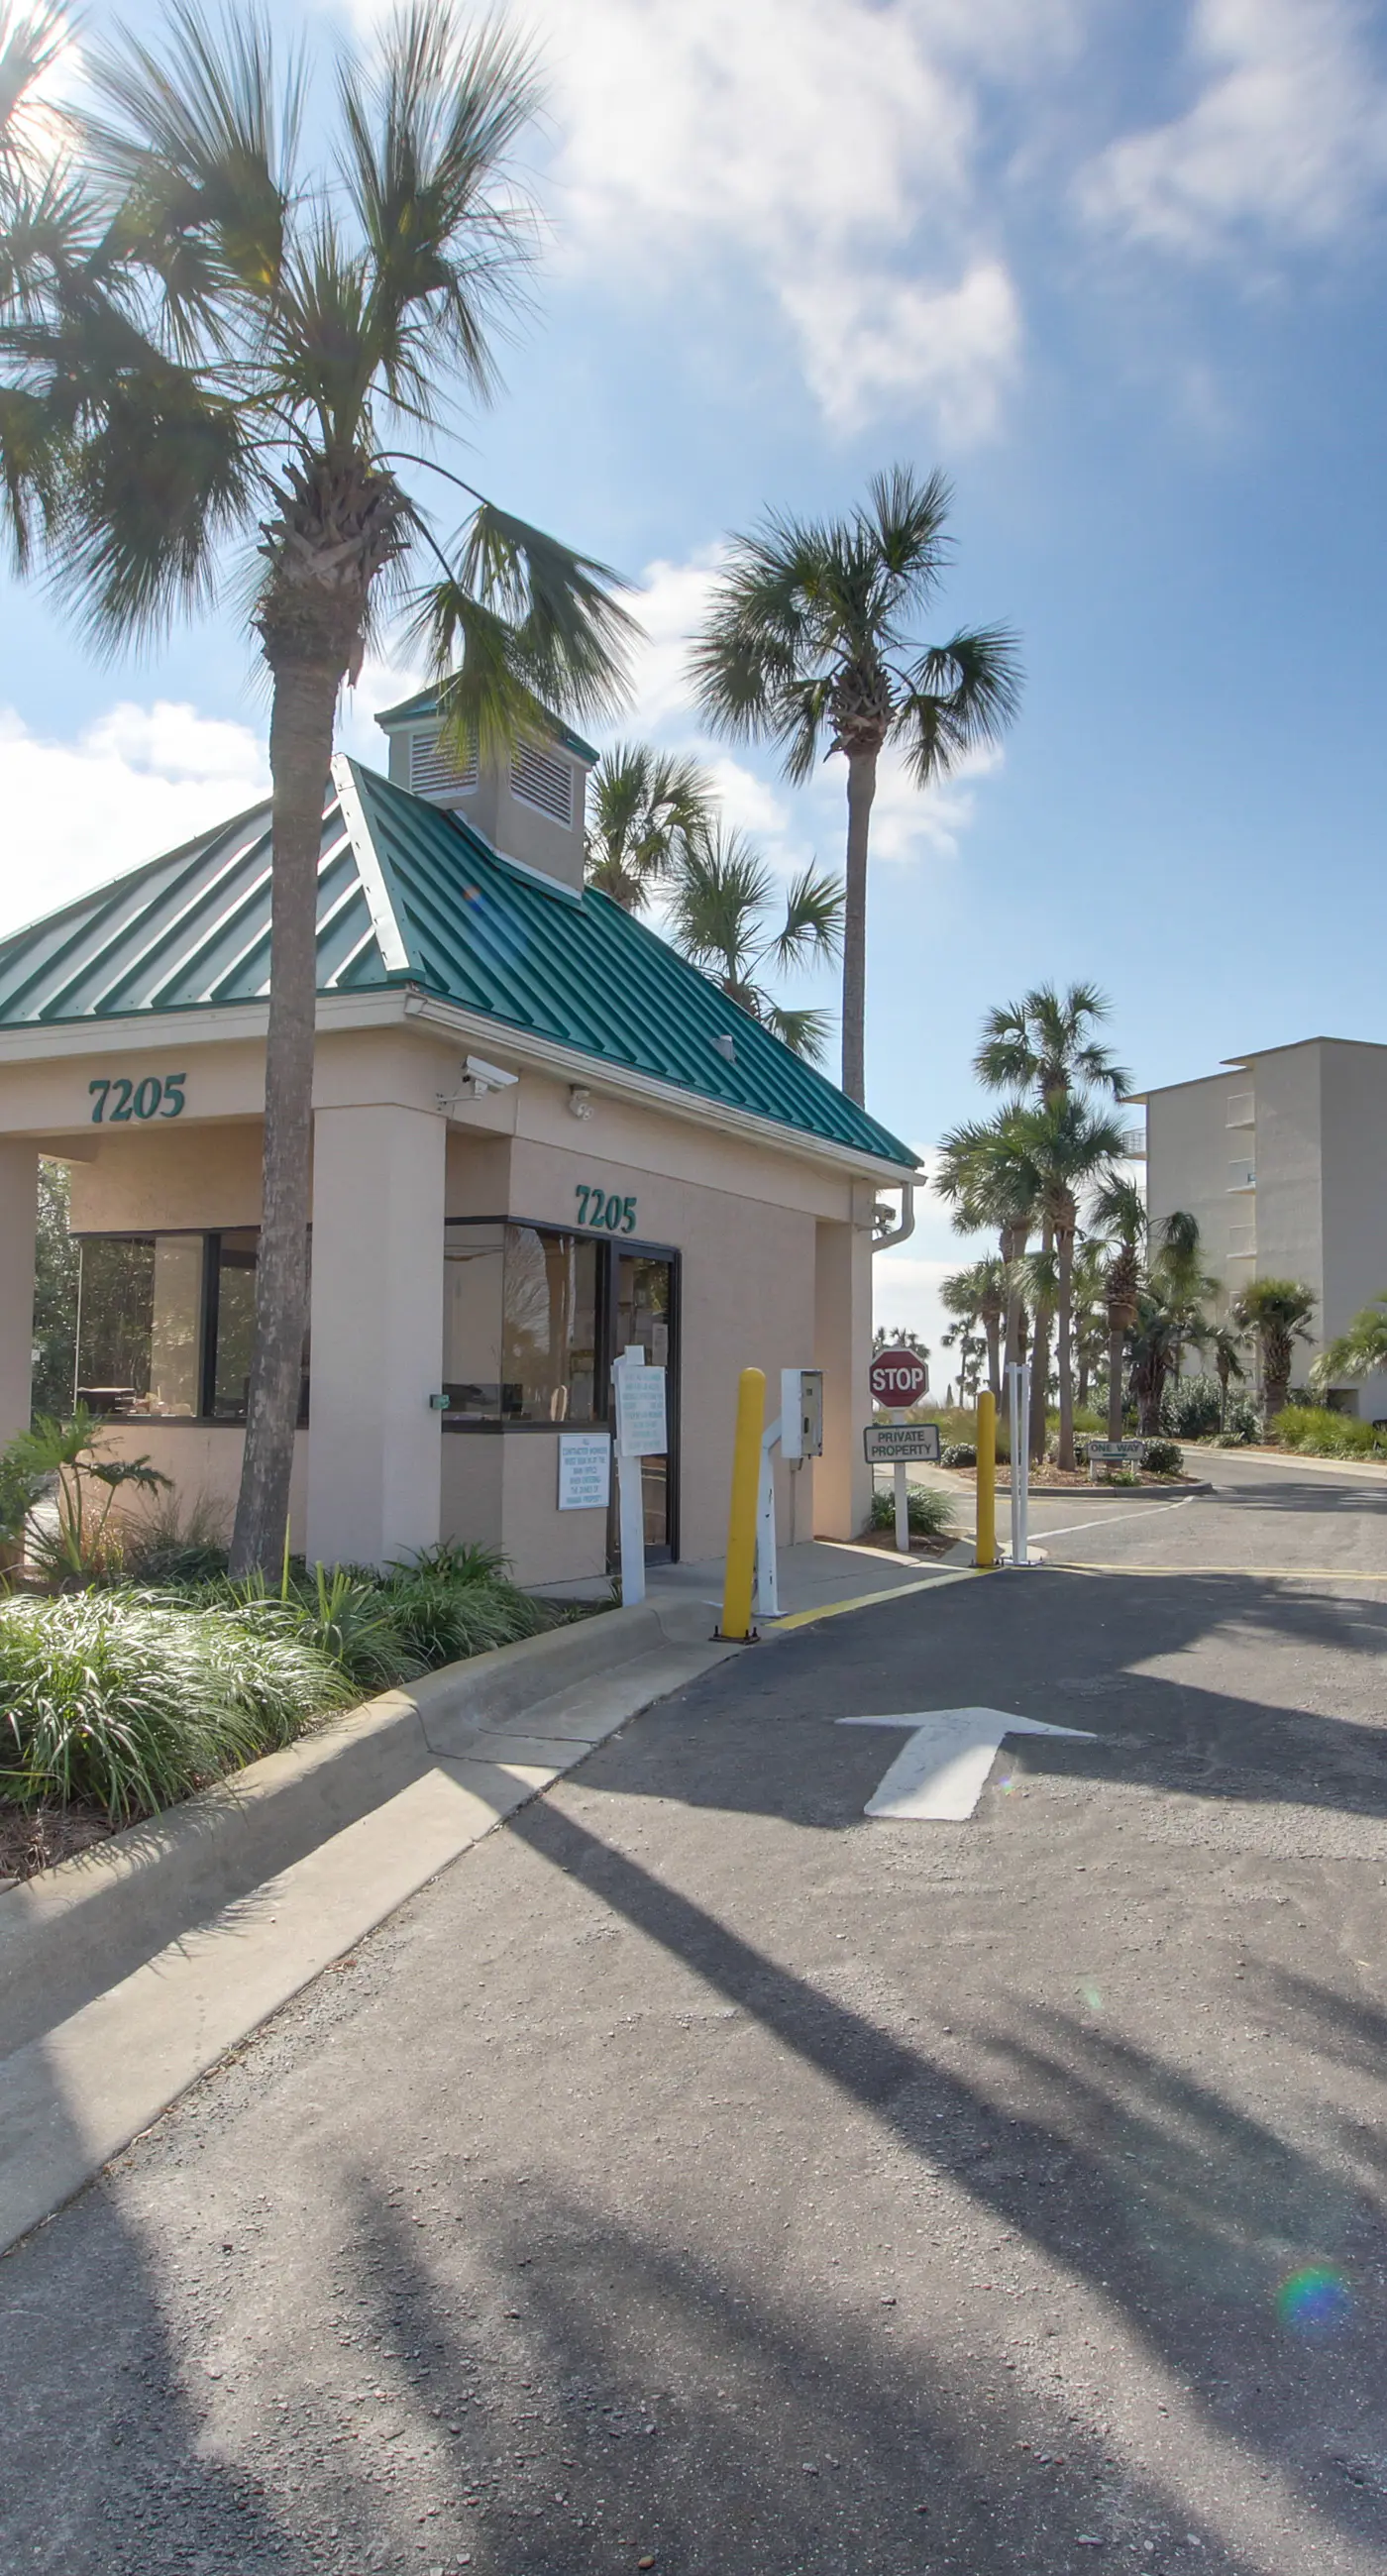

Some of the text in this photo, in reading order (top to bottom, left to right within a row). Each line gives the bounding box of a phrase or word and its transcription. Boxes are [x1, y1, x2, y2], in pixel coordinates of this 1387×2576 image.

[89, 1072, 186, 1124] 7205
[576, 1184, 637, 1234] 7205
[872, 1367, 923, 1391] STOP
[878, 1430, 925, 1443] PRIVATE
[872, 1444, 932, 1456] PROPERTY
[1091, 1444, 1139, 1452] ONE WAY
